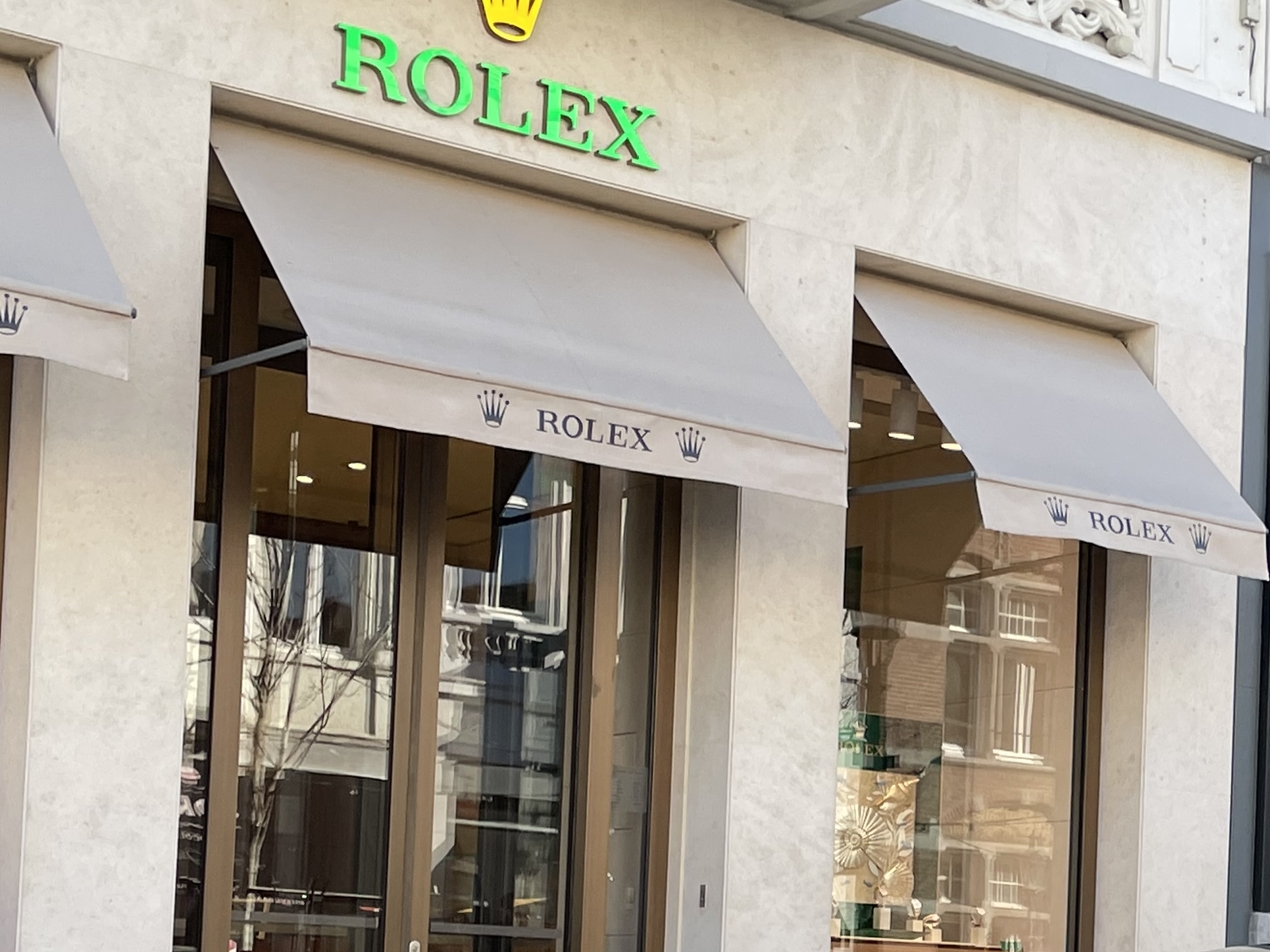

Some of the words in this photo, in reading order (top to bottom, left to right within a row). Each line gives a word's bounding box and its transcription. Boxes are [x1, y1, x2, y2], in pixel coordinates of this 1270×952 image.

[332, 22, 660, 171] ROLEX
[536, 408, 653, 452] ROLEX
[1088, 511, 1175, 545] ROLEX
